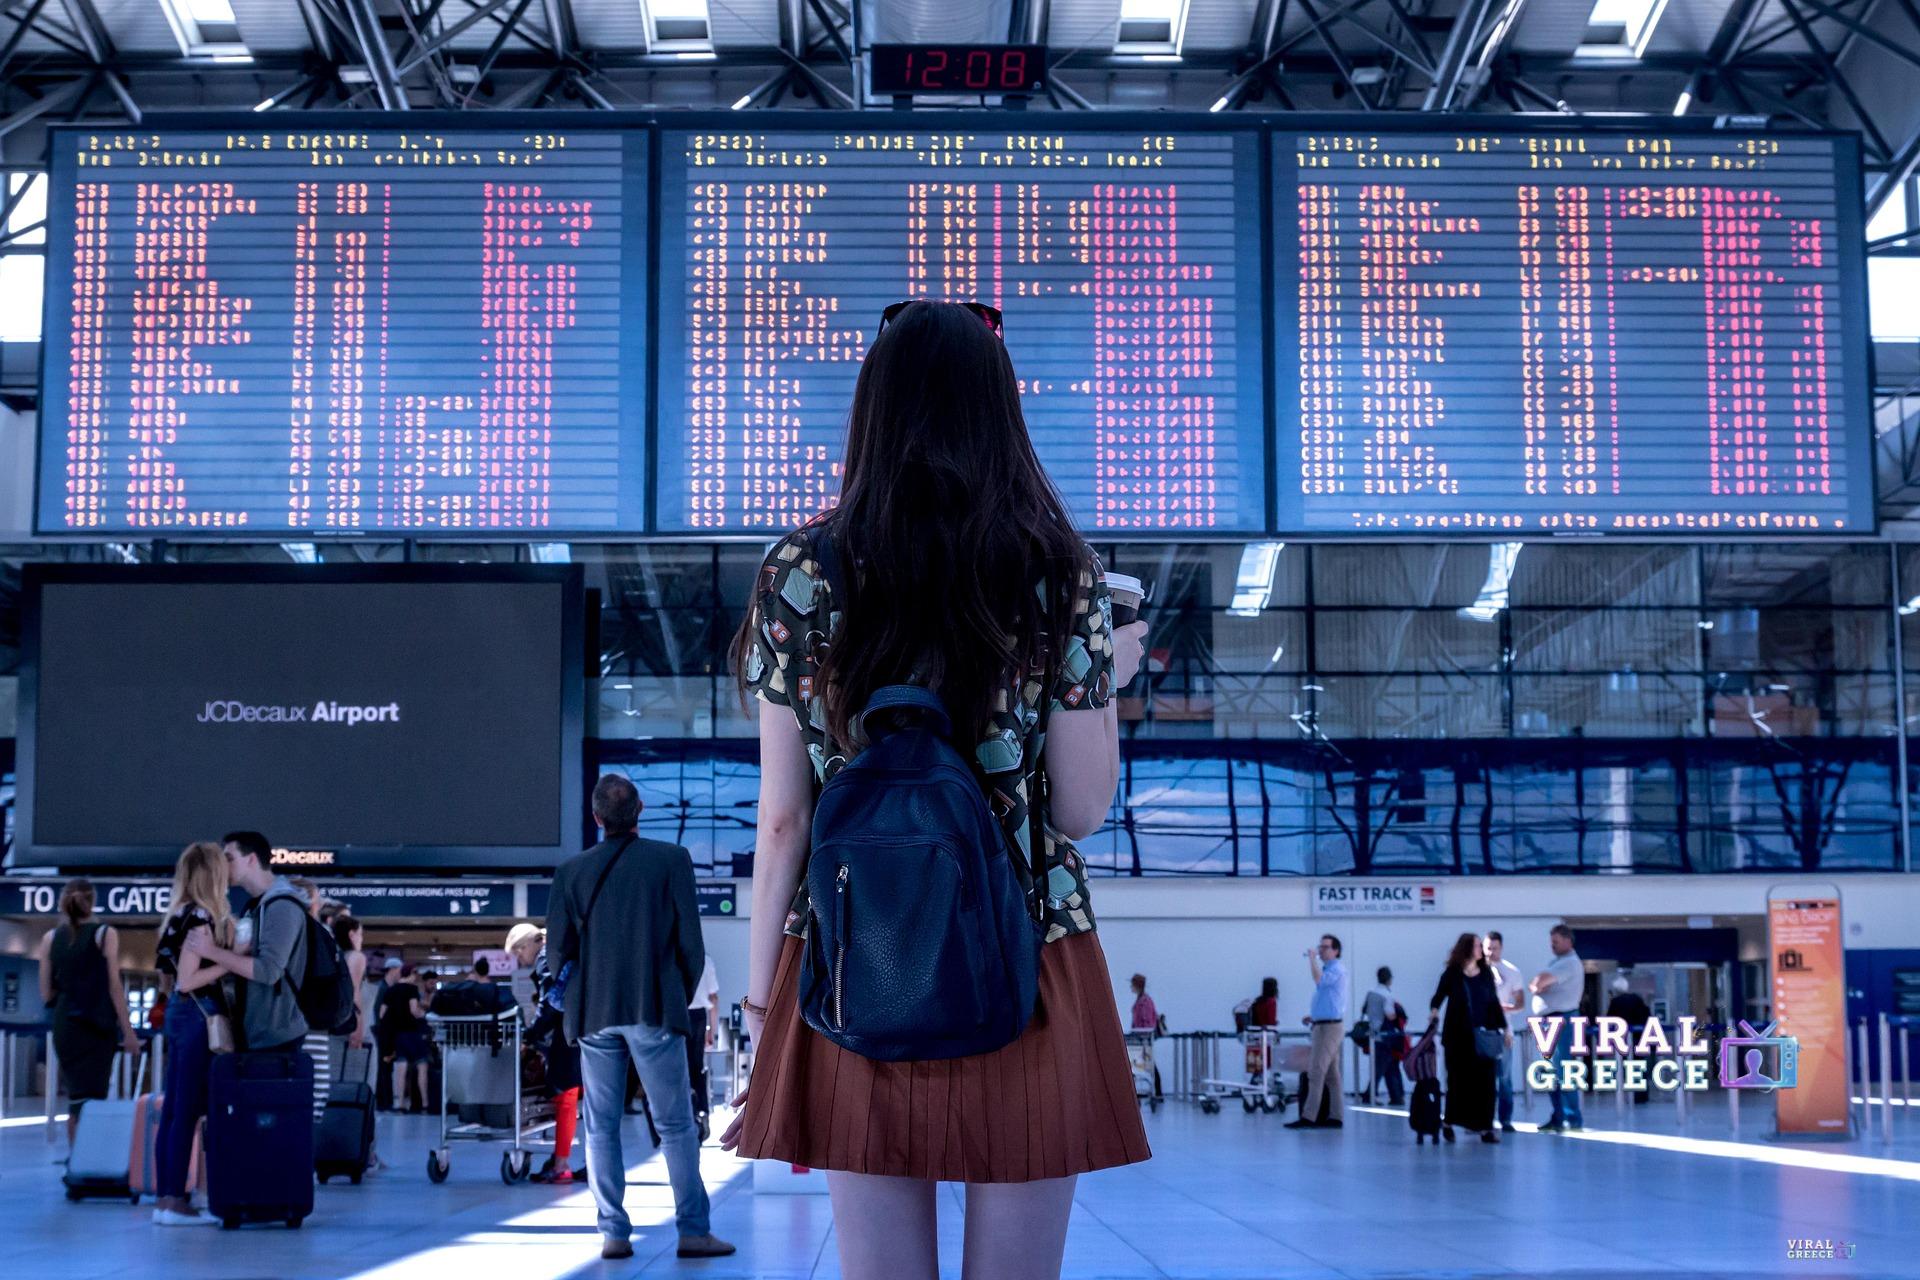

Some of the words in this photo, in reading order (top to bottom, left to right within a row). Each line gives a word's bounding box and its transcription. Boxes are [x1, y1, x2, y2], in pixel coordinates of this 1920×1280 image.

[904, 50, 1027, 88] 12:08
[196, 701, 307, 723] JCDecaux
[311, 701, 400, 726] Airport
[19, 886, 55, 912] TO
[1319, 887, 1356, 901] FAST
[1362, 887, 1412, 901] TRACK
